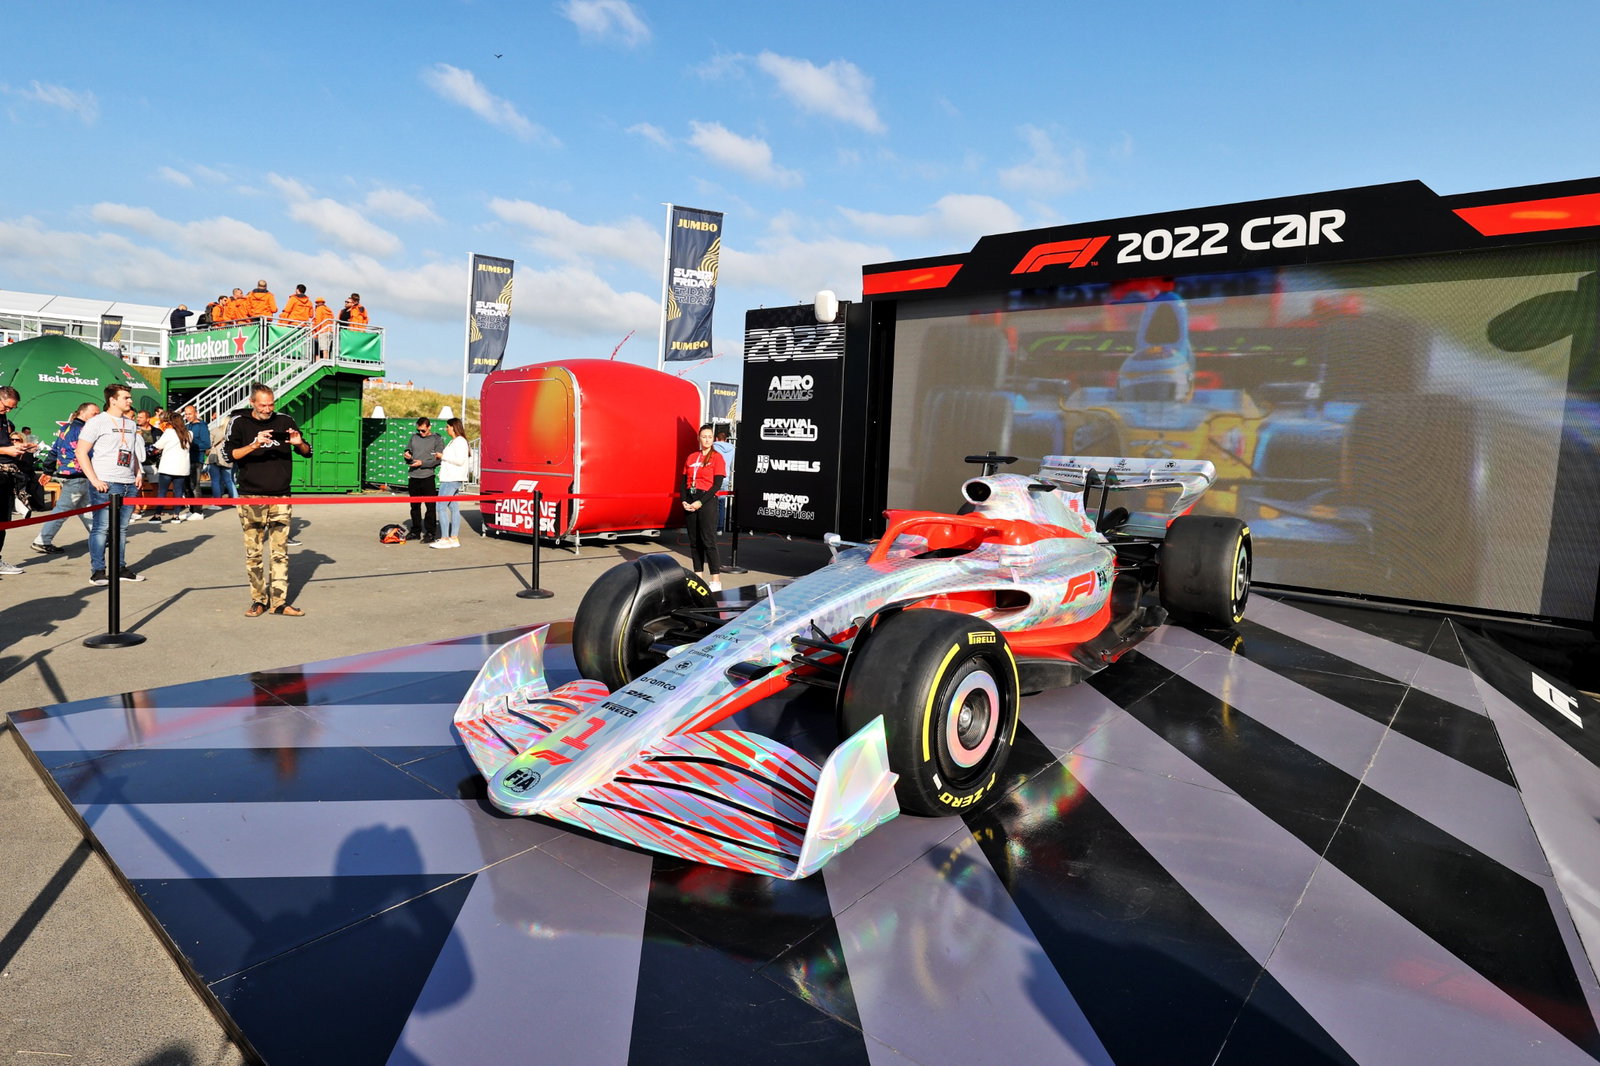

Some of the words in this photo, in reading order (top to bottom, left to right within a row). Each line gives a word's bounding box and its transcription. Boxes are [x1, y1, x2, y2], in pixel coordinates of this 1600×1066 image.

[677, 218, 718, 232] JUMBO
[1116, 222, 1229, 264] 2022
[478, 264, 511, 274] JUMBO
[673, 267, 714, 281] SUPER
[673, 276, 712, 289] FRIDAY
[673, 286, 712, 297] FRIDAY
[475, 301, 509, 311] SUPER
[674, 294, 712, 305] FRIDAY
[475, 308, 508, 318] FRIDAY
[176, 335, 230, 361] Heineken
[671, 341, 709, 351] JUMBO
[747, 324, 839, 362] 2022
[38, 374, 99, 386] Heineken
[768, 375, 814, 390] AERO
[713, 389, 737, 397] JUMBO
[767, 390, 814, 401] DYNAMICS
[763, 419, 812, 429] SURVIVAL
[788, 428, 814, 438] CELL
[770, 459, 821, 473] WHEELS
[763, 493, 809, 504] IMPROVED
[768, 501, 804, 511] ENERGY
[757, 507, 815, 520] ABSORPTION
[495, 512, 524, 528] HELP
[524, 516, 556, 533] DSK
[968, 631, 996, 645] PIRELLI
[640, 676, 676, 691] aramco
[601, 701, 638, 718] PIRELLI
[939, 786, 984, 808] ZERO
